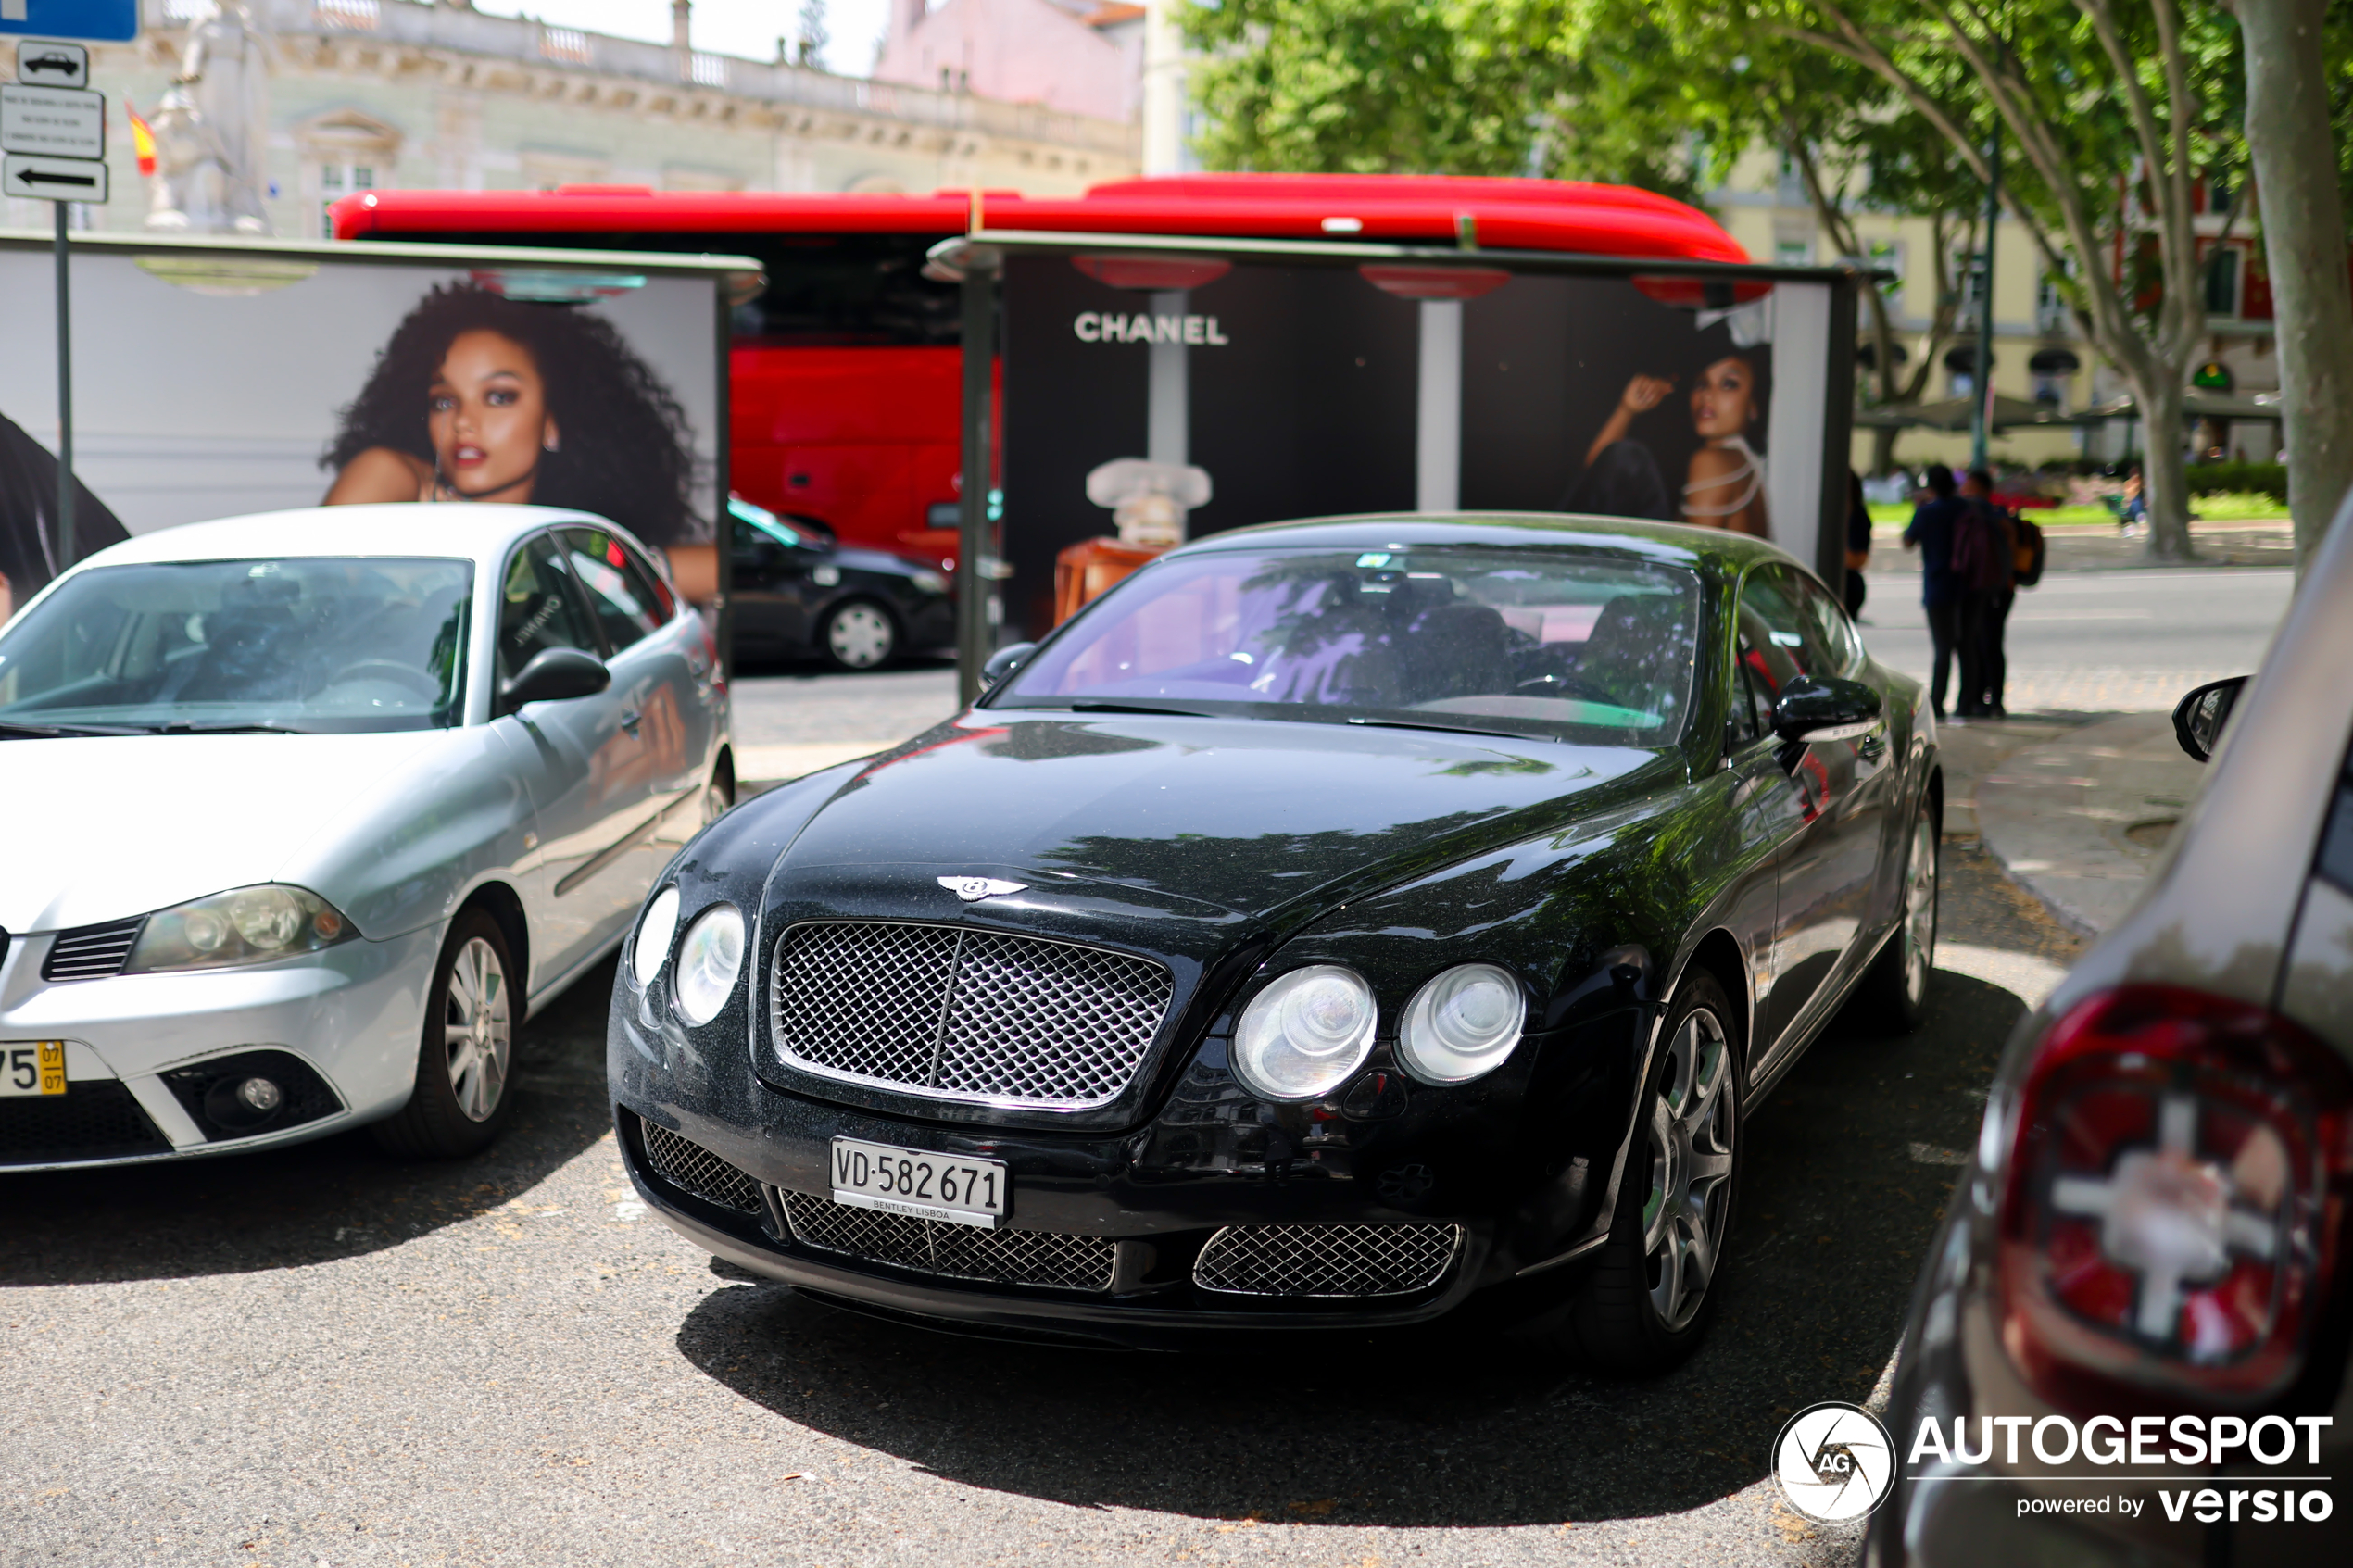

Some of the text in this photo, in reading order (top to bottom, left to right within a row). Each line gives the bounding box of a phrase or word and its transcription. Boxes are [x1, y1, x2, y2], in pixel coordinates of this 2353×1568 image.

[1074, 311, 1229, 346] CHANEL
[42, 1047, 59, 1062] 07
[0, 1049, 36, 1090] 5
[44, 1075, 62, 1089] 07
[874, 1200, 950, 1220] BENTLEY LISBOA
